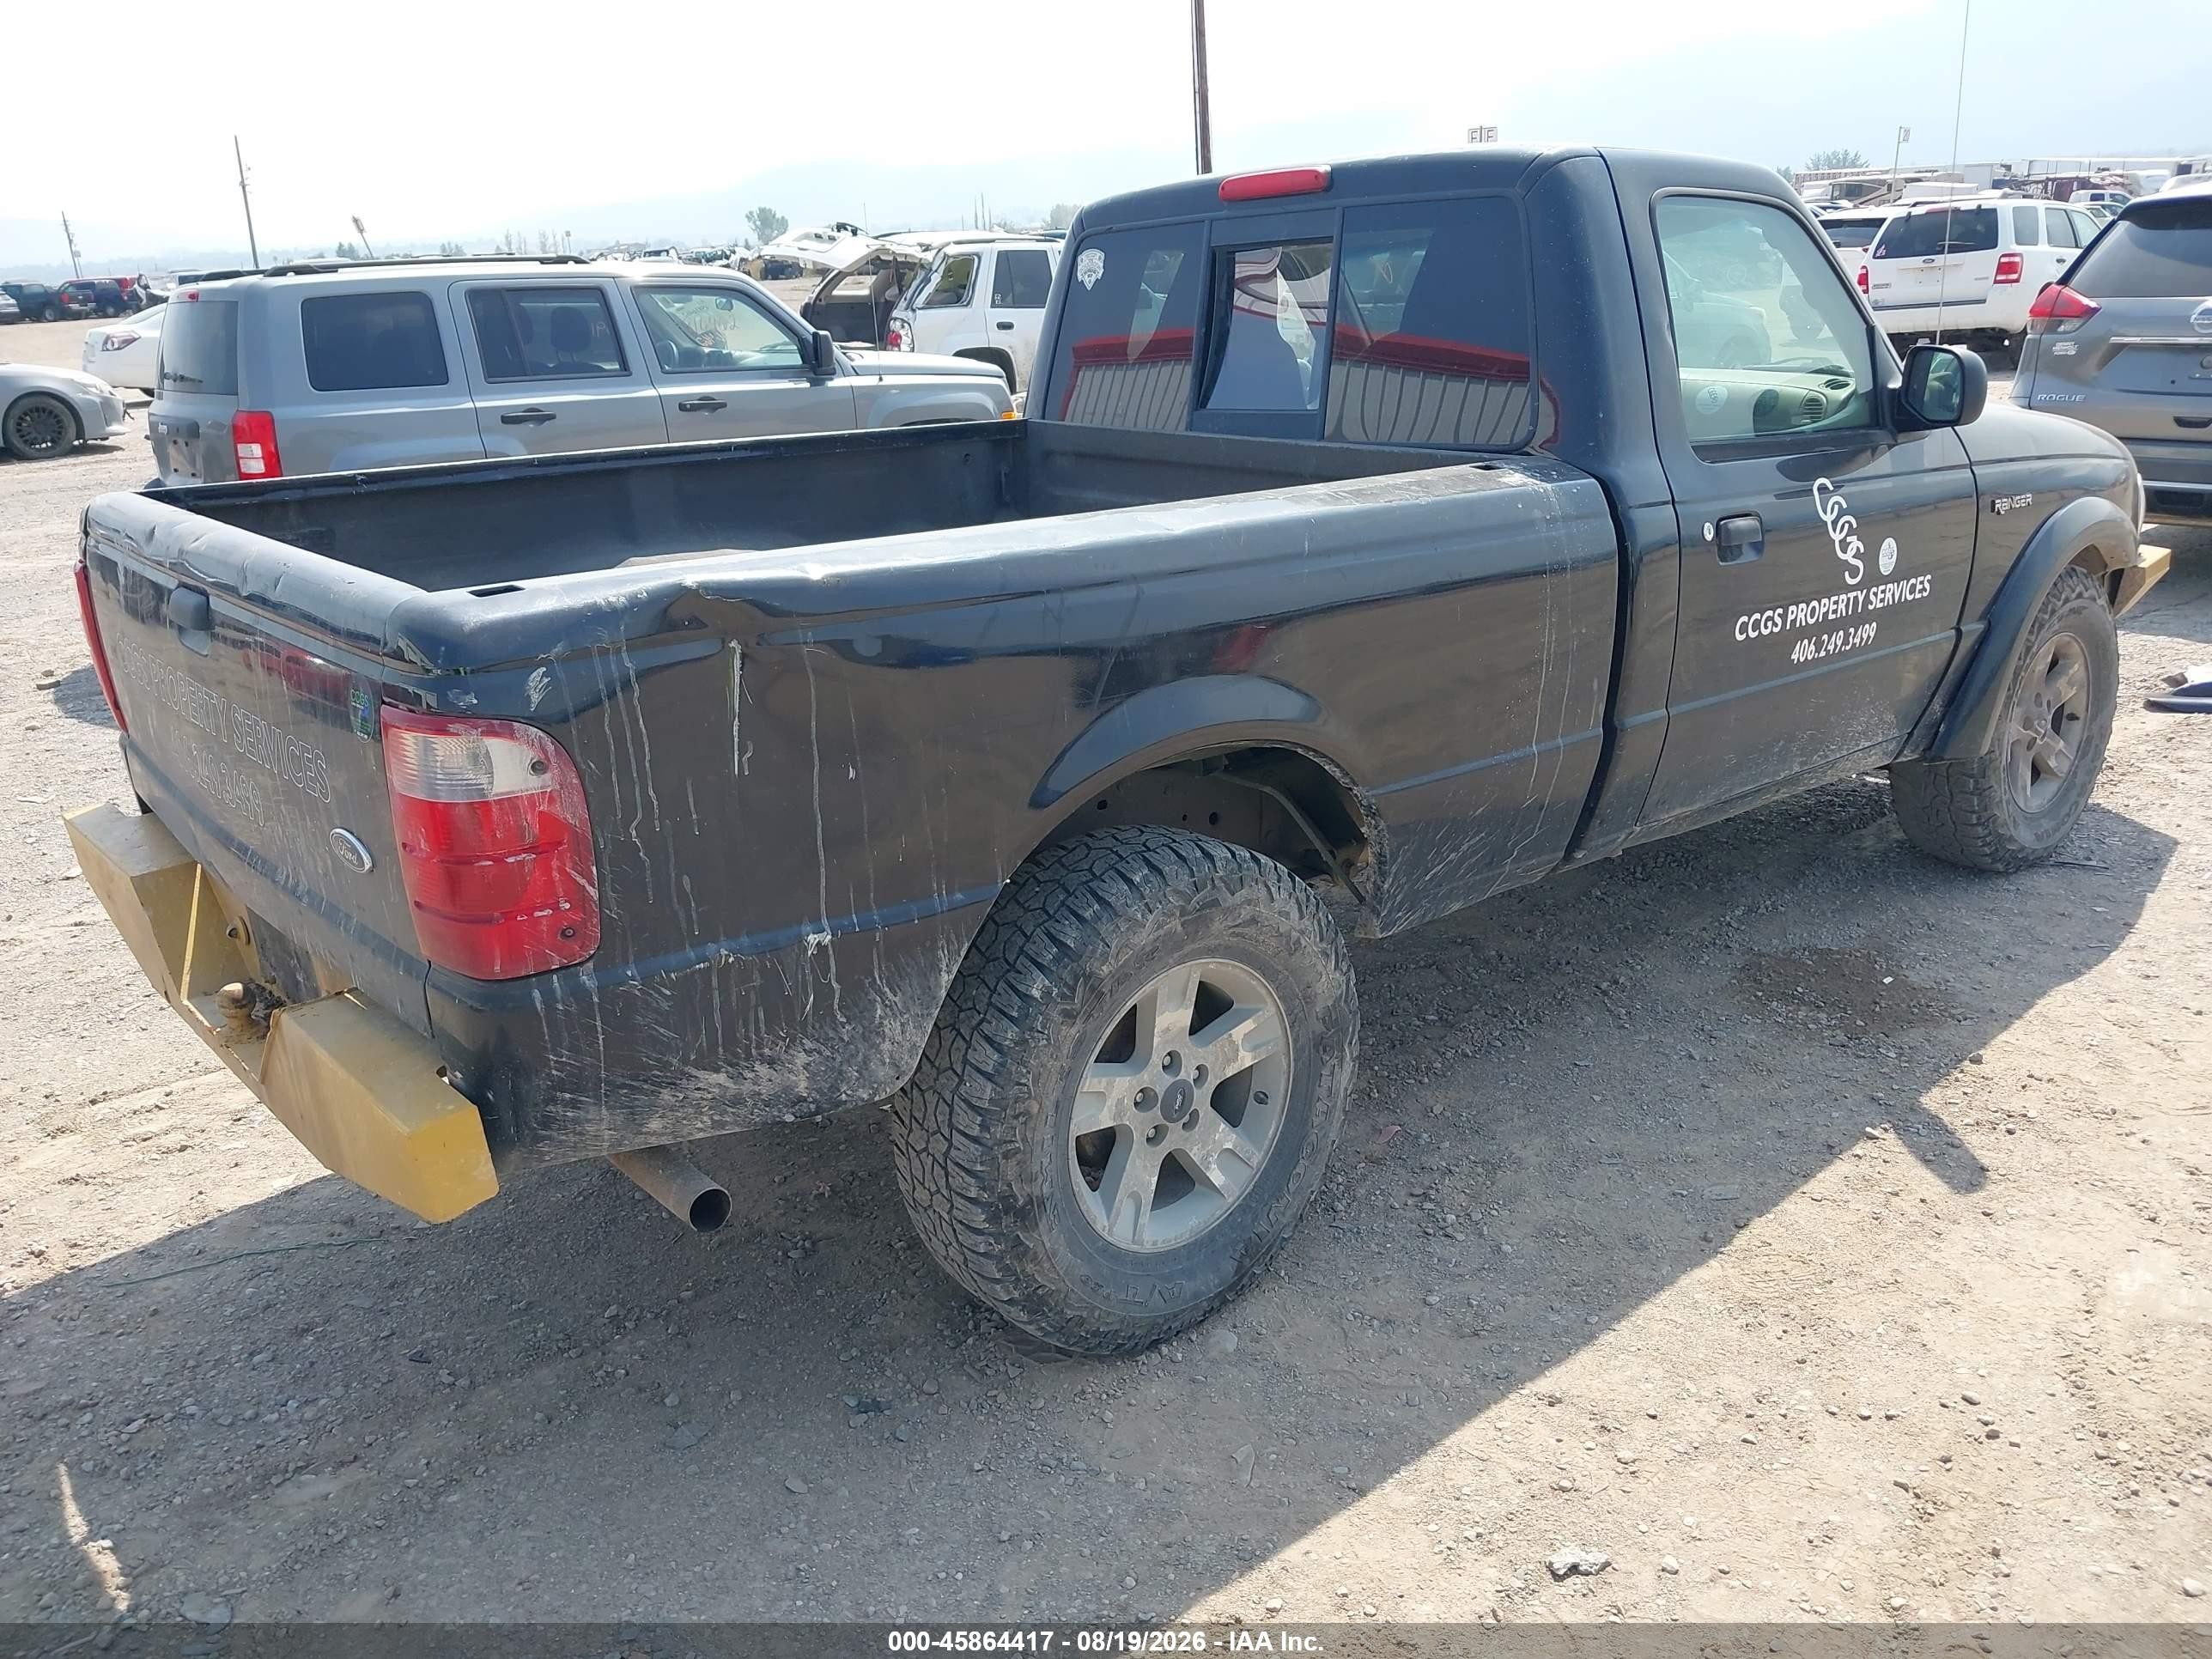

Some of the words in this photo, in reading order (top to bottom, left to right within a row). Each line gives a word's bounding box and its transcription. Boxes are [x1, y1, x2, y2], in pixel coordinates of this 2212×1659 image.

[1995, 494, 2033, 515] RANGER
[1735, 608, 1783, 641] CCGS
[1786, 588, 1868, 630] PROPERTY
[1868, 574, 1932, 611] SERVICES
[1790, 621, 1877, 665] 406.249.3499
[149, 653, 228, 743] PROPERTY
[230, 703, 331, 803] SERVICES
[339, 838, 358, 866] Ford
